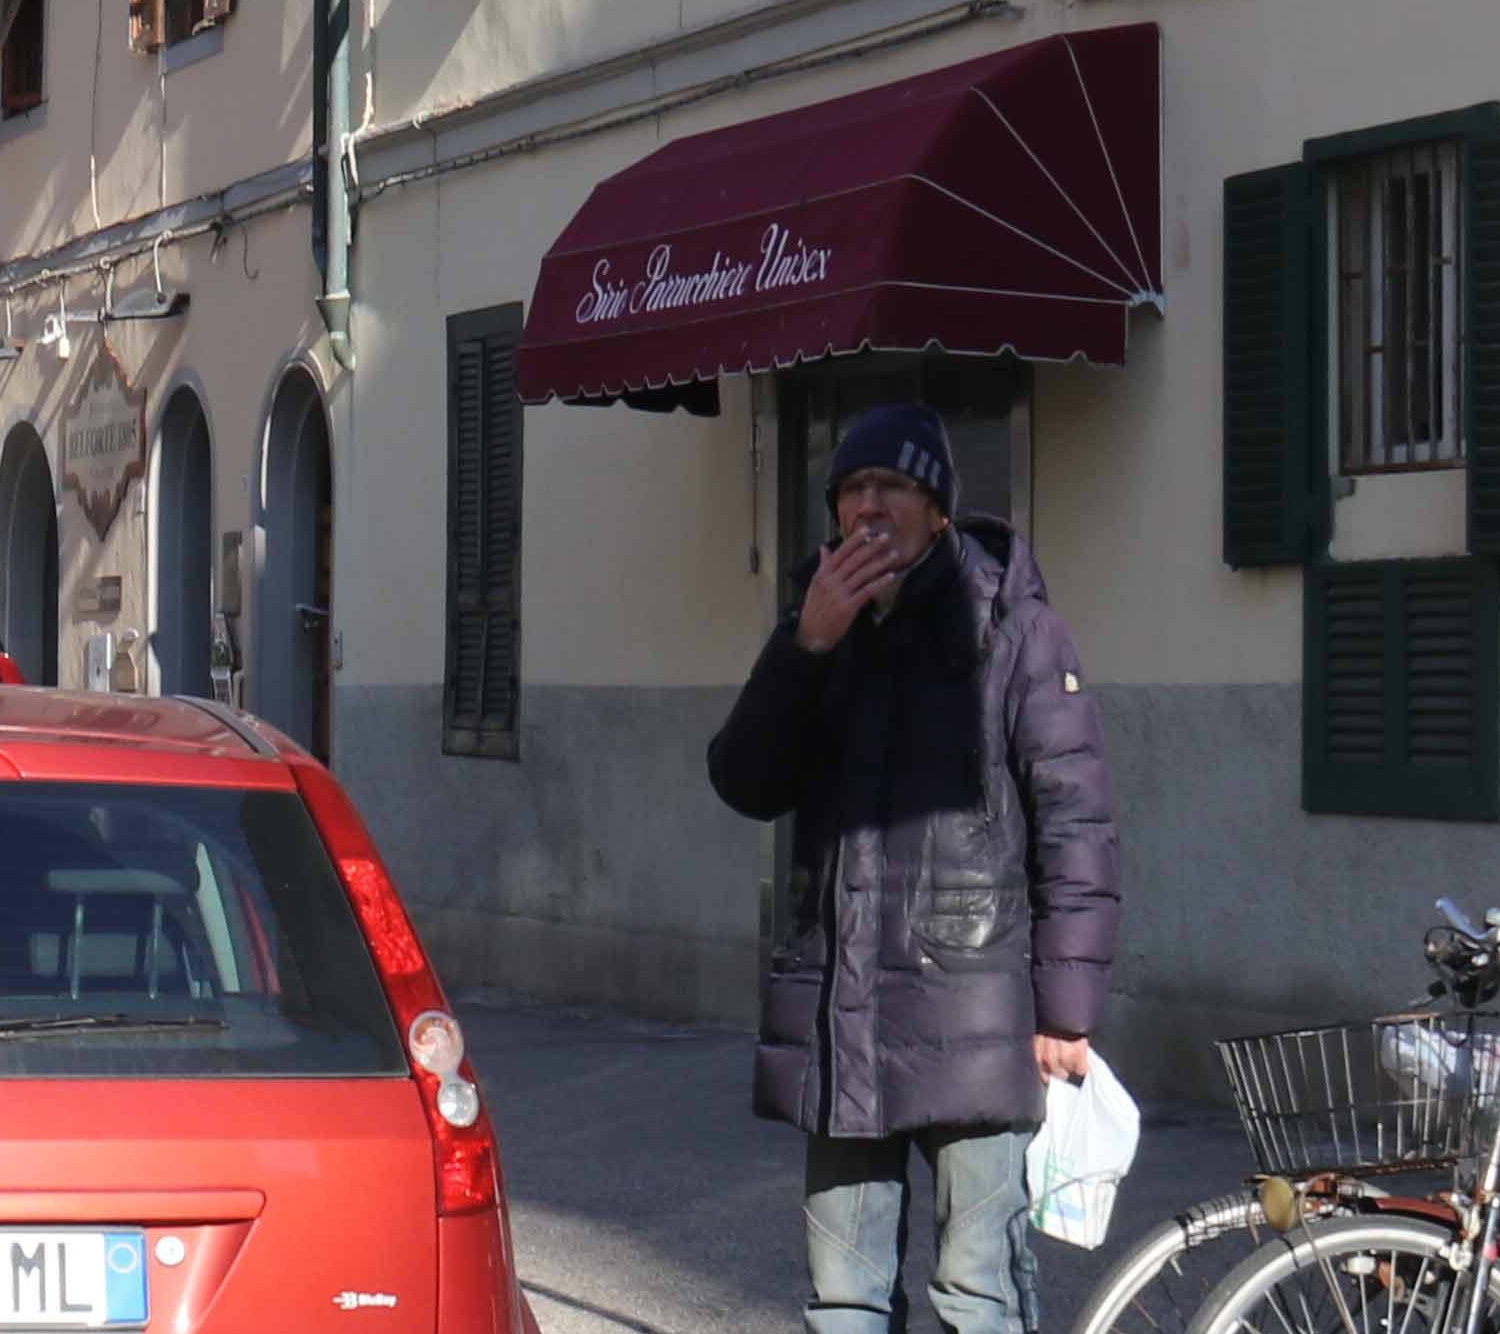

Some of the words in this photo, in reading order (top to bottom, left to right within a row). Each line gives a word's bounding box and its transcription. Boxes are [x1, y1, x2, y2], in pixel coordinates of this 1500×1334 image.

[576, 258, 629, 323] Sirio
[629, 244, 753, 314] Parrucchiere
[755, 223, 831, 292] Unisex
